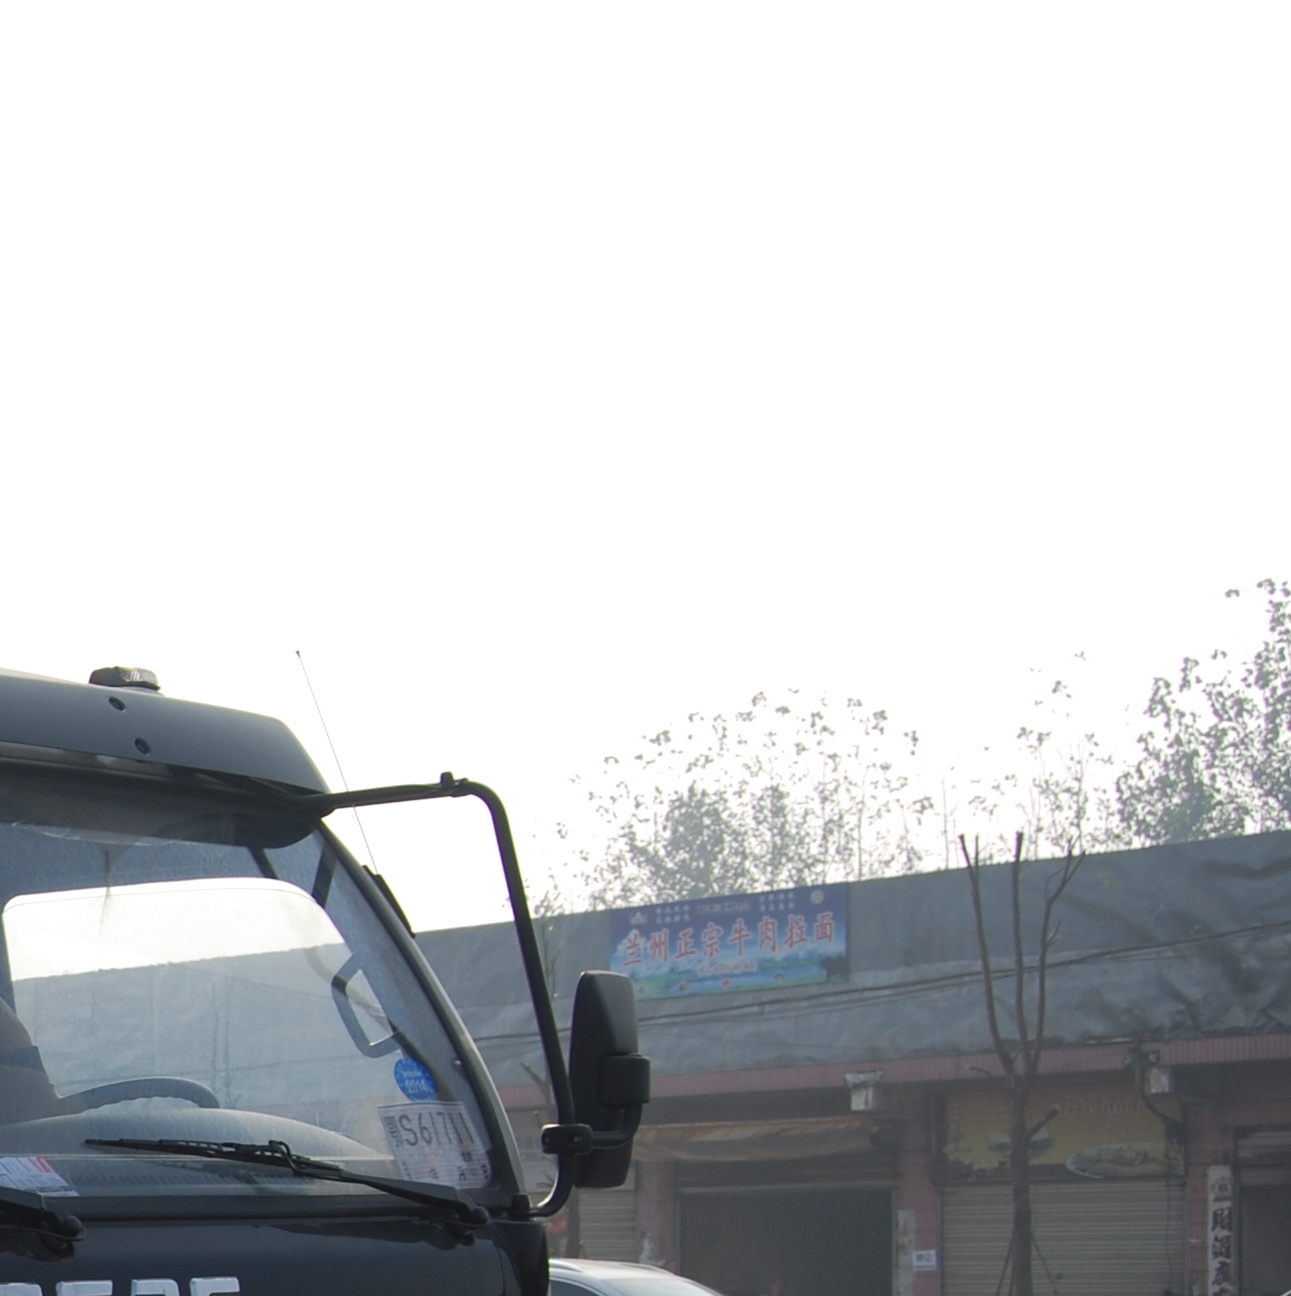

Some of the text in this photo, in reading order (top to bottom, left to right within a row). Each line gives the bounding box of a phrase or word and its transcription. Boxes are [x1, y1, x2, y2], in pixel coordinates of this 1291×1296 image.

[623, 911, 836, 966] 兰州正宗牛肉拉面
